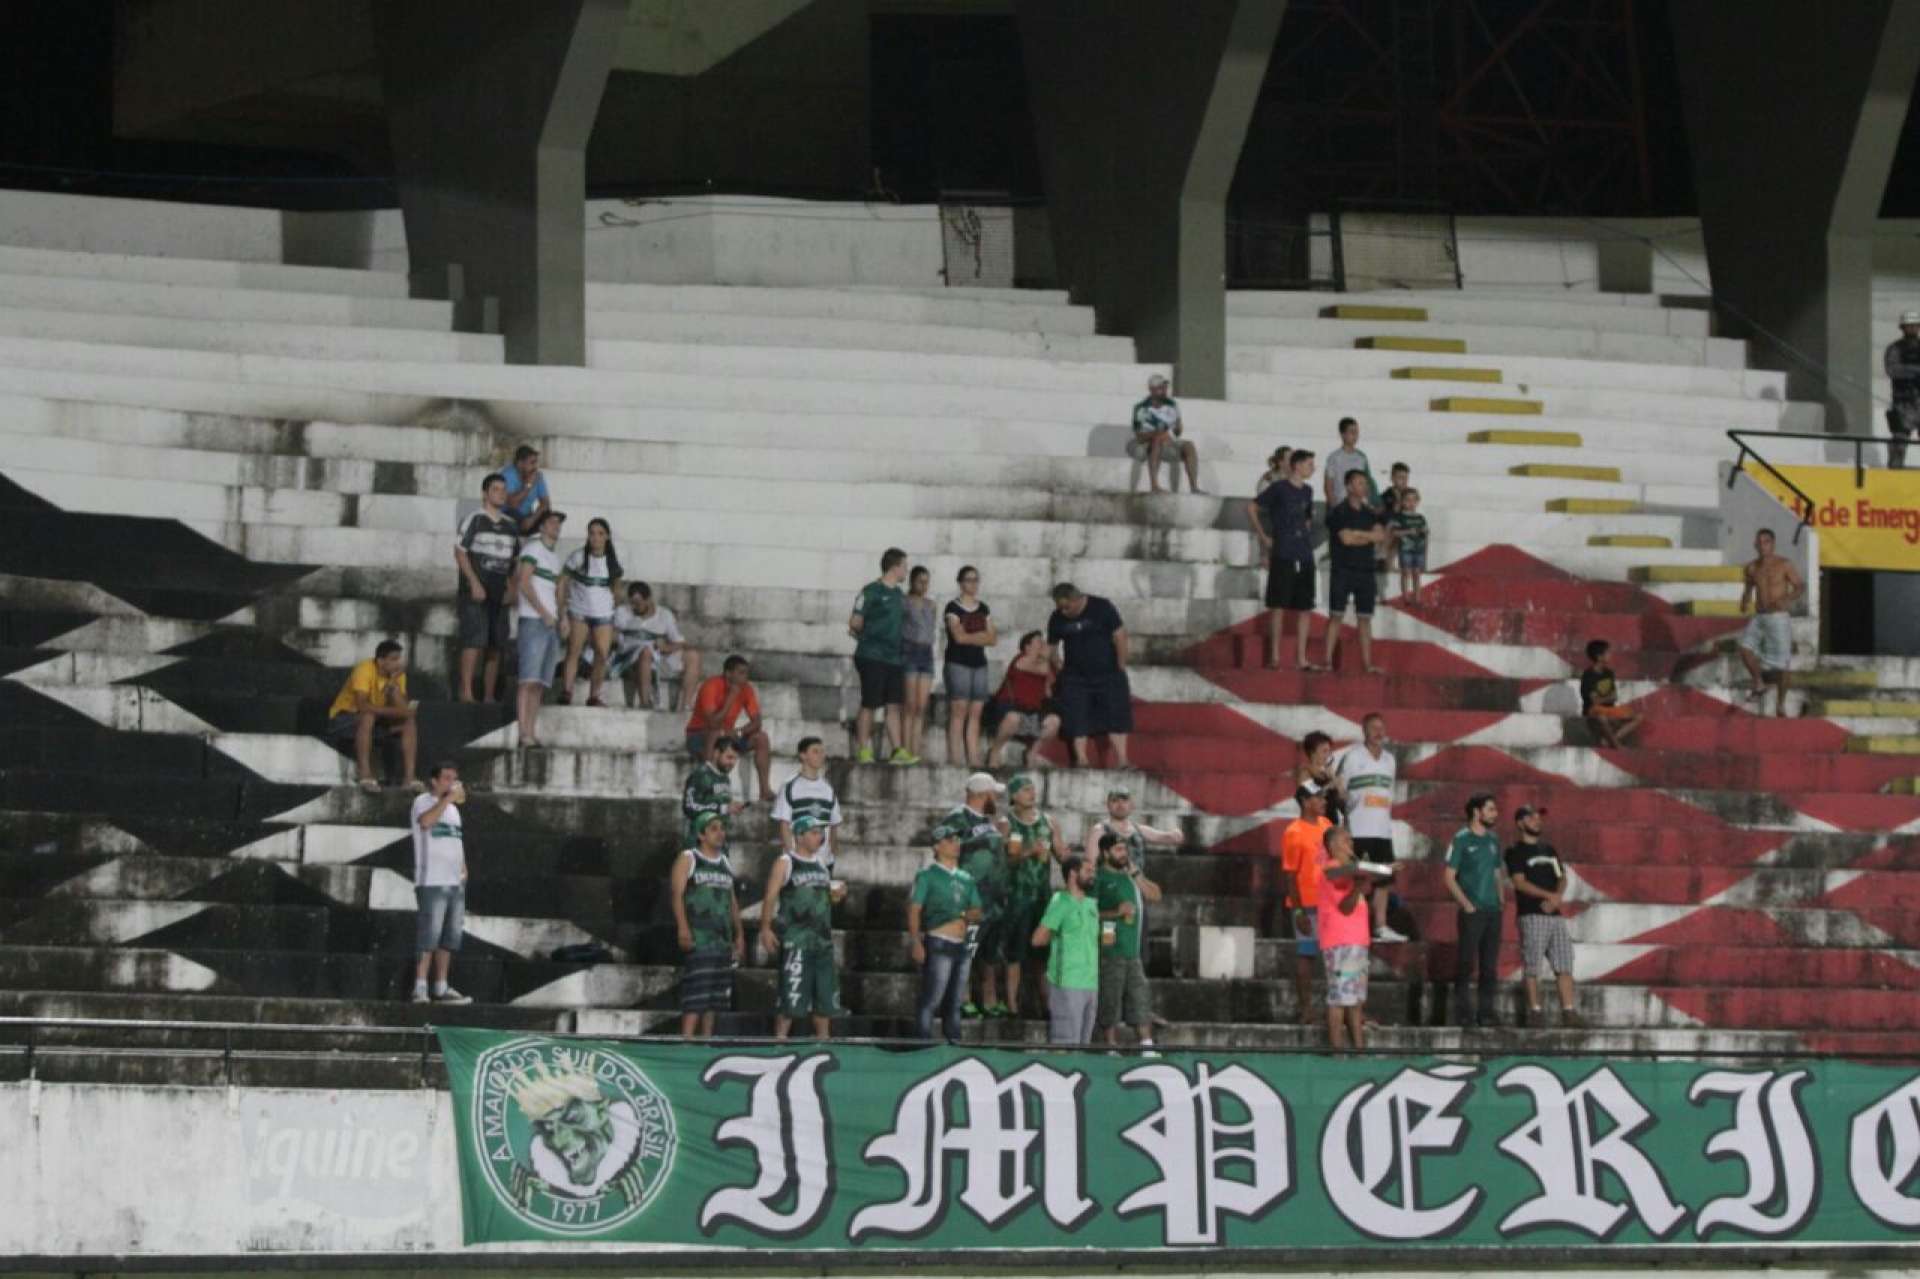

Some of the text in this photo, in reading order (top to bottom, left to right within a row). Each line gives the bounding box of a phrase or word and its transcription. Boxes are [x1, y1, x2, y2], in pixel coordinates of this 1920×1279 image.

[1820, 498, 1850, 527] de
[1857, 498, 1920, 544] Emerg
[485, 1060, 514, 1136] MAIOR
[635, 1095, 664, 1158] BRASIL
[491, 1143, 515, 1161] A
[552, 1200, 600, 1221] 1977
